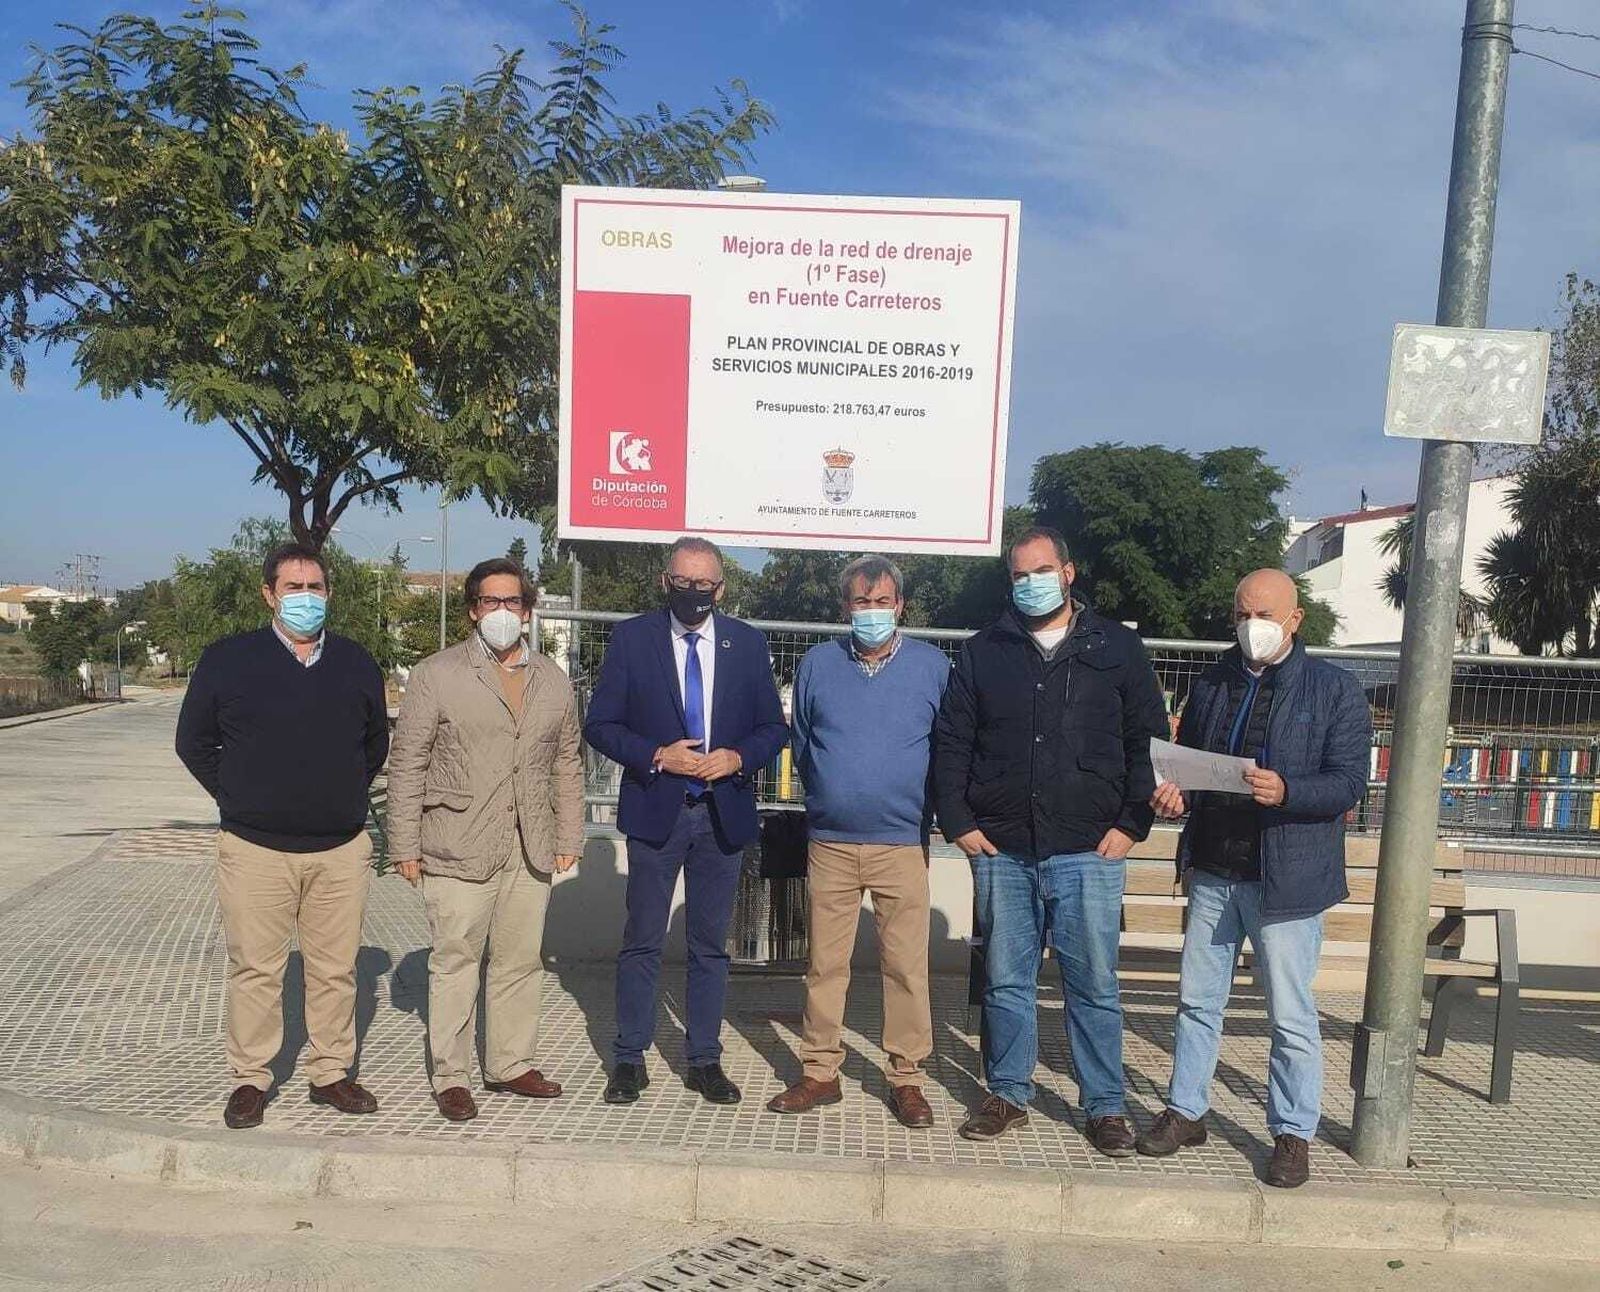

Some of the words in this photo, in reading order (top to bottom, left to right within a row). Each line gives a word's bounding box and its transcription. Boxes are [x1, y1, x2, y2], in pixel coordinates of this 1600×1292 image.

[601, 229, 673, 249] OBRAS
[723, 236, 784, 258] Mejora
[791, 238, 812, 256] de
[819, 239, 833, 256] la
[841, 241, 869, 258] red
[876, 241, 897, 259] de
[904, 243, 972, 264] drenaje
[837, 265, 885, 287] Fase)
[749, 291, 769, 304] en
[777, 288, 838, 306] Fuente
[846, 290, 941, 310] Carreteros
[728, 336, 766, 350] PLAN
[772, 338, 862, 353] PROVINCIAL
[868, 341, 887, 354] DE
[893, 342, 945, 356] OBRAS
[951, 344, 959, 356] Y
[713, 358, 791, 374] SERVICIOS
[797, 361, 897, 377] MUNICIPALES
[903, 365, 973, 380] 2016-2019
[756, 401, 829, 413] Presupuesto:
[833, 404, 890, 416] 218.763,47
[894, 408, 925, 417] euros
[592, 478, 667, 493] Diputación
[591, 493, 608, 506] de
[758, 506, 816, 515] AYUNTAMIENTO
[819, 508, 829, 516] DE
[832, 509, 861, 517] FUENTE
[864, 510, 916, 519] CARRETEROS
